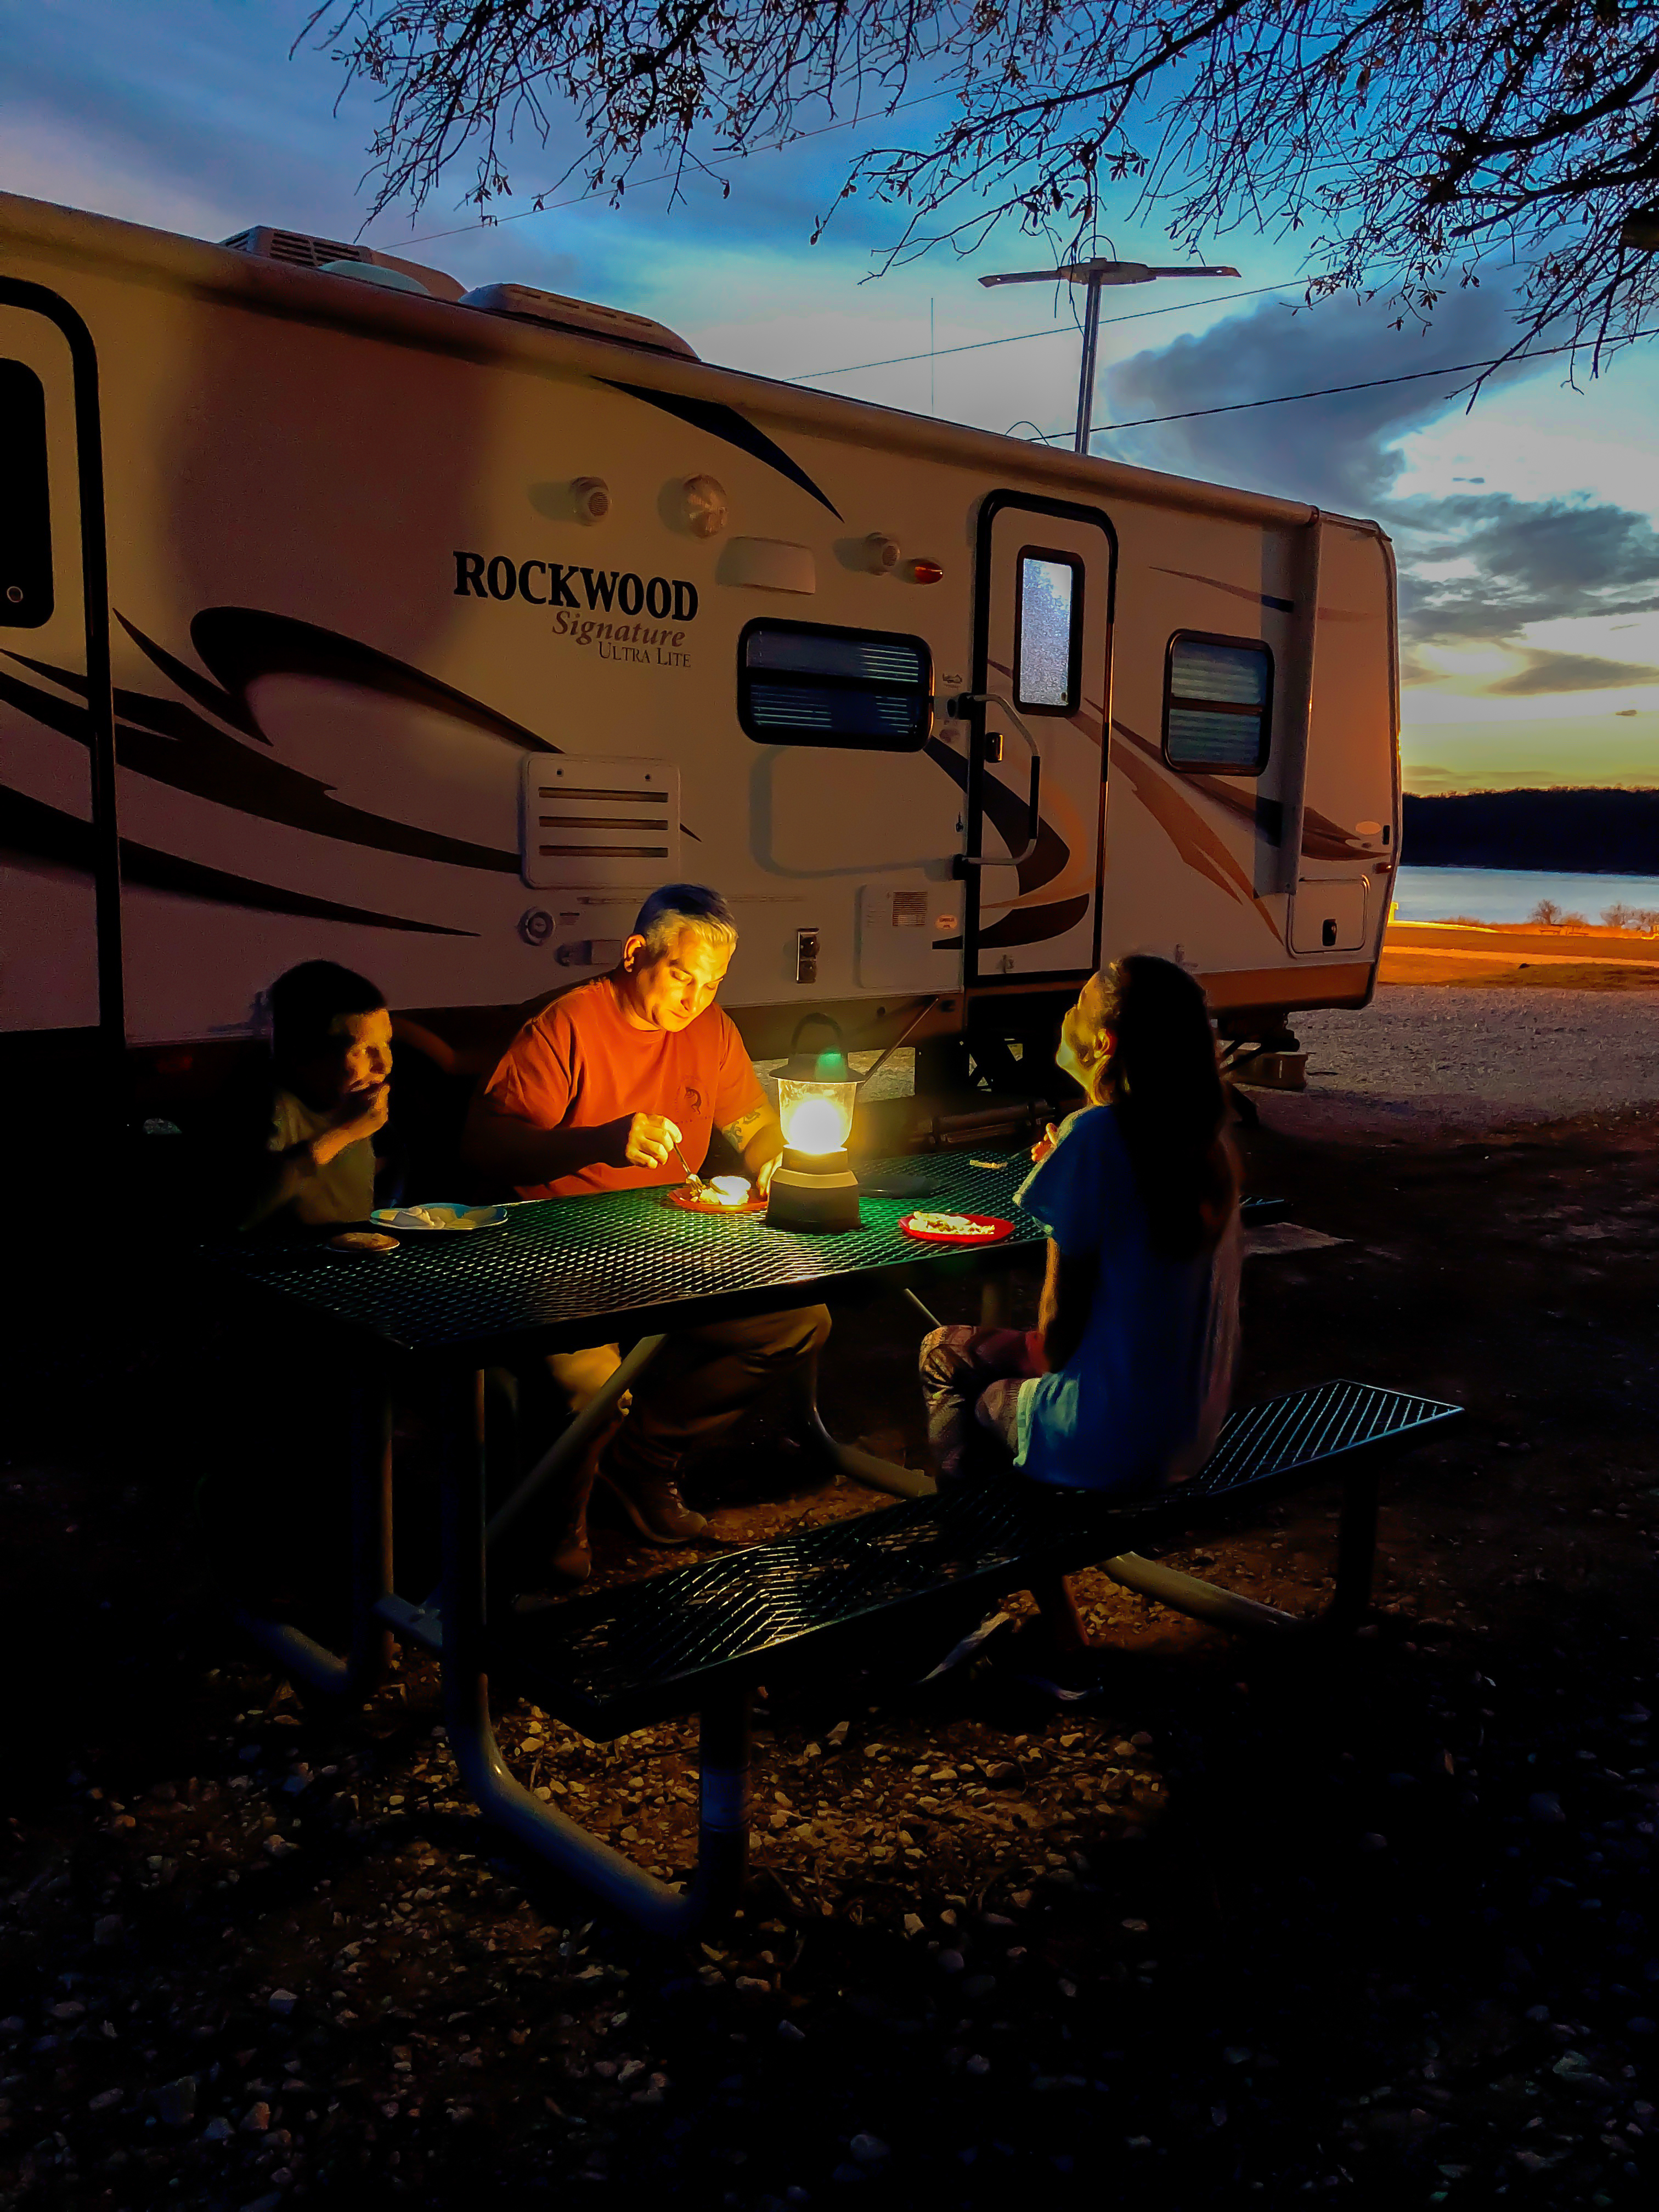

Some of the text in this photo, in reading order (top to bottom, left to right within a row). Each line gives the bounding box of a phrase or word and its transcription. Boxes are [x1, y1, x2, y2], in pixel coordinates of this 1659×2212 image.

[453, 551, 699, 621] ROCKWOOD
[552, 611, 685, 647] Signature
[599, 641, 691, 668] ULTRA LITE
